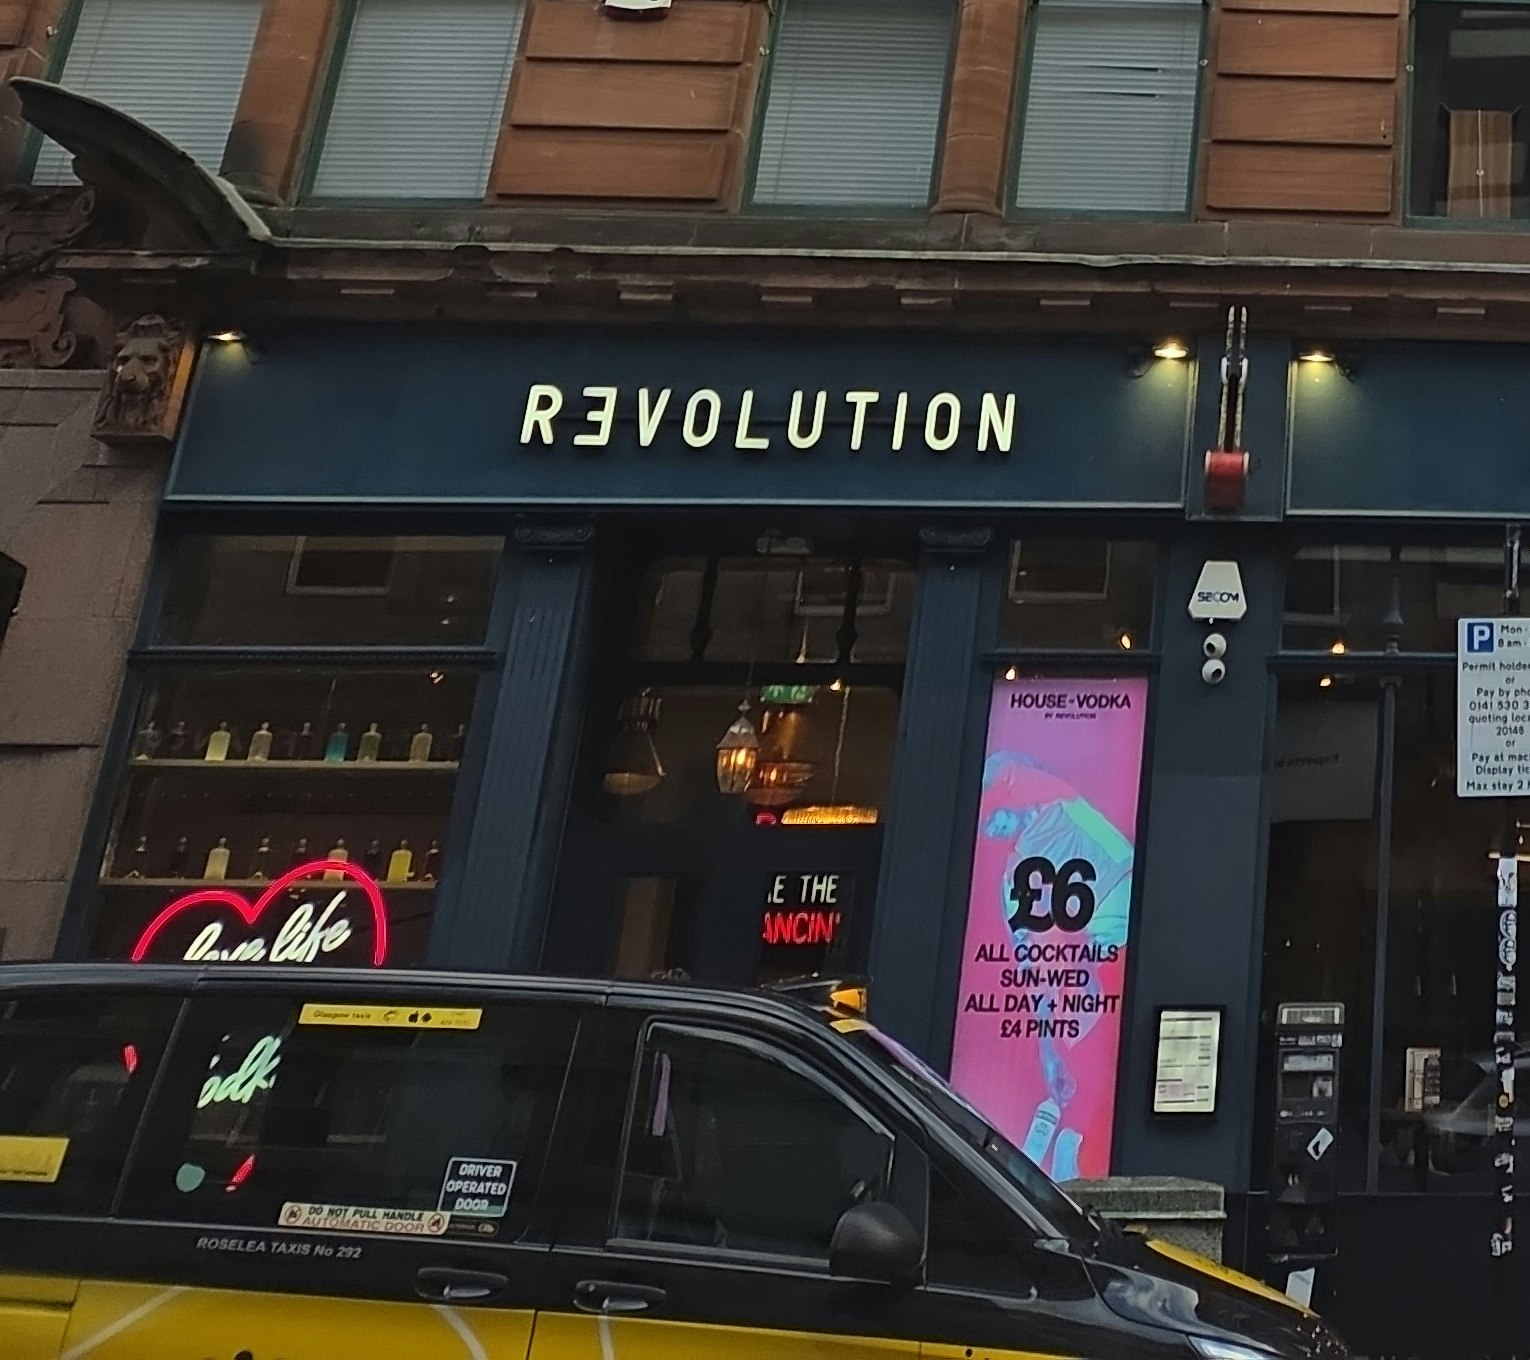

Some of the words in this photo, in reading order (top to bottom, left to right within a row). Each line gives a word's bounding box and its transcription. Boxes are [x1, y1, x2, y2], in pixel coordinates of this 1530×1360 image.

[519, 384, 1018, 453] REVOLUTION
[1196, 590, 1240, 604] SECOM
[1500, 624, 1522, 634] Mon
[1462, 662, 1496, 671] Permit
[1505, 676, 1515, 684] or
[1476, 687, 1494, 699] Pay
[1498, 687, 1510, 698] by
[1469, 701, 1493, 711] 0141
[1468, 712, 1508, 724] quoting
[1505, 740, 1515, 748] or
[1472, 752, 1490, 764] Pay
[1494, 753, 1504, 762] at
[1476, 764, 1513, 776] Display
[1466, 780, 1487, 791] Max
[1491, 780, 1513, 792] stay
[1517, 780, 1523, 790] 2
[800, 874, 840, 903] THE
[1008, 856, 1097, 933] £6
[269, 890, 353, 962] life
[974, 943, 1010, 963] ALL
[1014, 943, 1119, 963] COCKTAILS
[1000, 969, 1090, 988] SUN-WED
[964, 993, 1000, 1012] ALL
[1004, 993, 1044, 1012] DAY
[1047, 1001, 1058, 1012] +
[1062, 994, 1120, 1013] NIGHT
[1000, 1019, 1022, 1038] £4
[1026, 1019, 1080, 1038] PINTS
[459, 1163, 503, 1178] DRIVER
[446, 1180, 507, 1196] OPERATED
[455, 1197, 489, 1211] DOOR
[307, 1206, 323, 1216] DO
[327, 1207, 349, 1217] NOT
[352, 1209, 377, 1219] PULL
[382, 1211, 425, 1222] HANDLE
[301, 1216, 381, 1230] AUTOMATIC
[384, 1221, 425, 1232] DOOR
[196, 1236, 267, 1253] ROSELEA
[270, 1241, 311, 1256] TAXIS
[313, 1244, 333, 1257] No
[336, 1246, 363, 1259] 292
